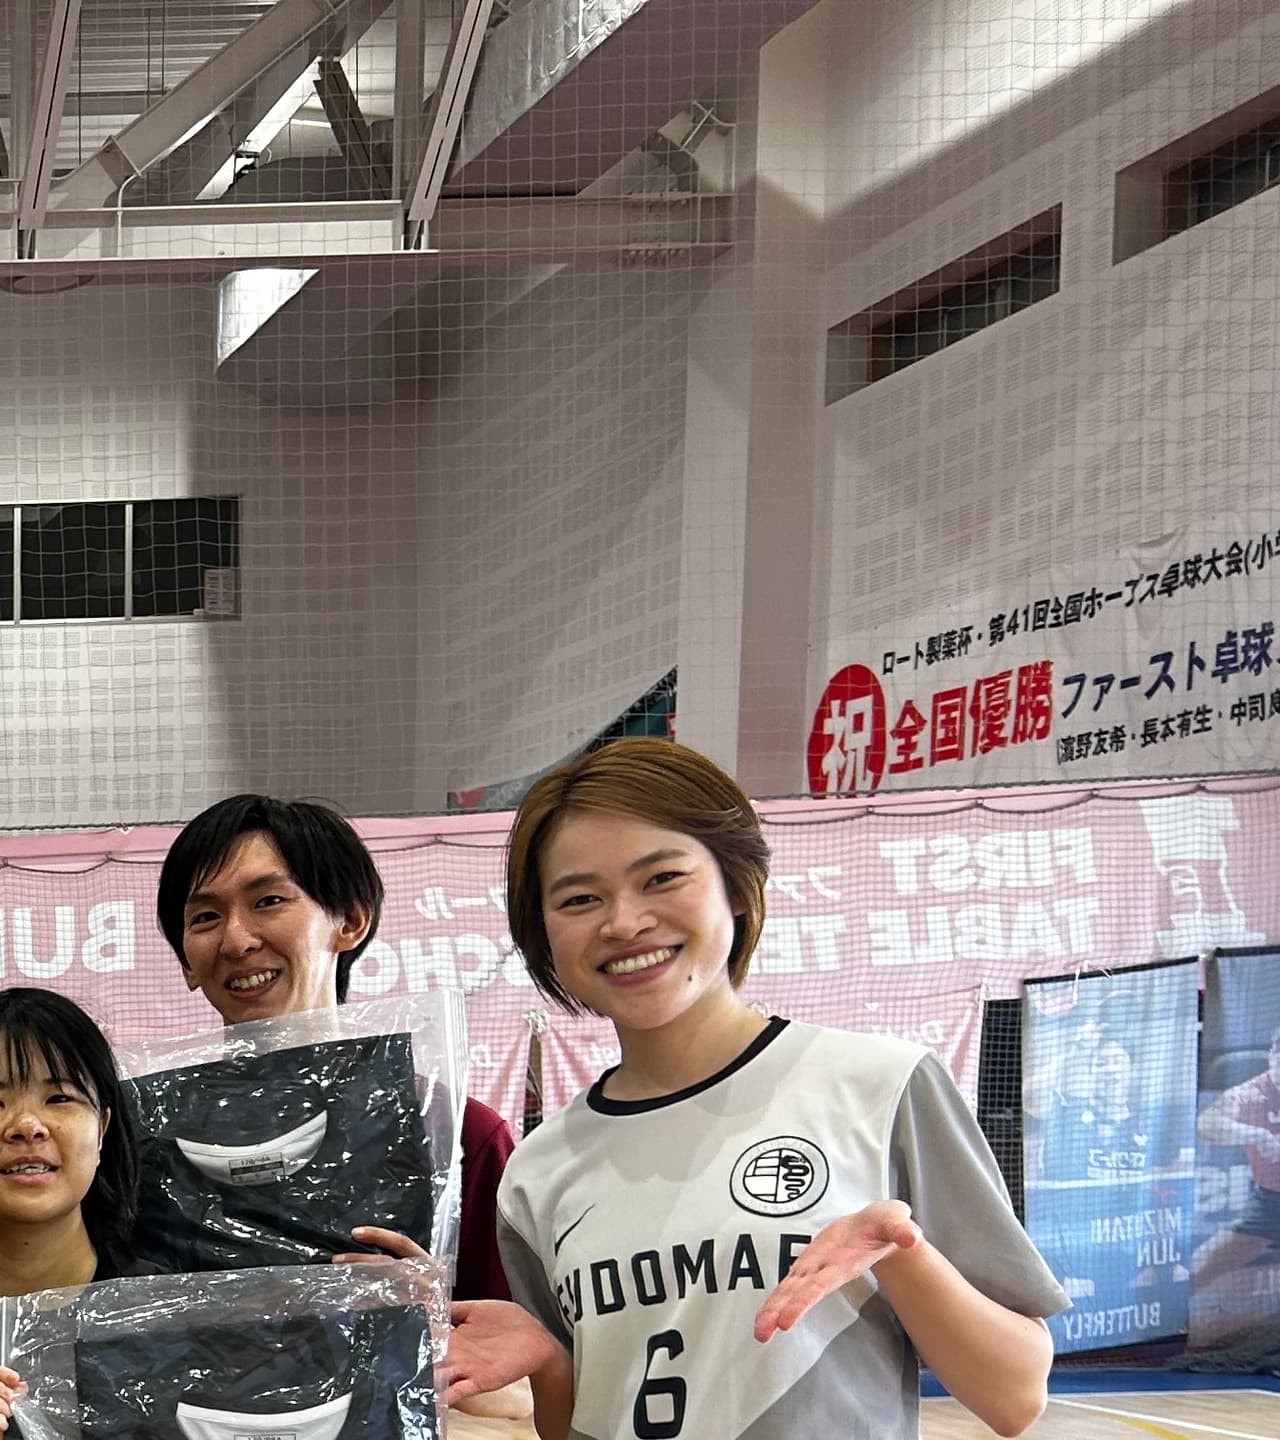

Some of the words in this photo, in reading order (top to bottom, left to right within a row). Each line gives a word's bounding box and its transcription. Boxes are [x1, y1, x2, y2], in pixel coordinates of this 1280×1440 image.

[889, 660, 1054, 775] 全国優勝
[1060, 620, 1280, 719] ファースト卓球
[821, 694, 874, 790] 祝
[633, 1329, 687, 1440] 6
